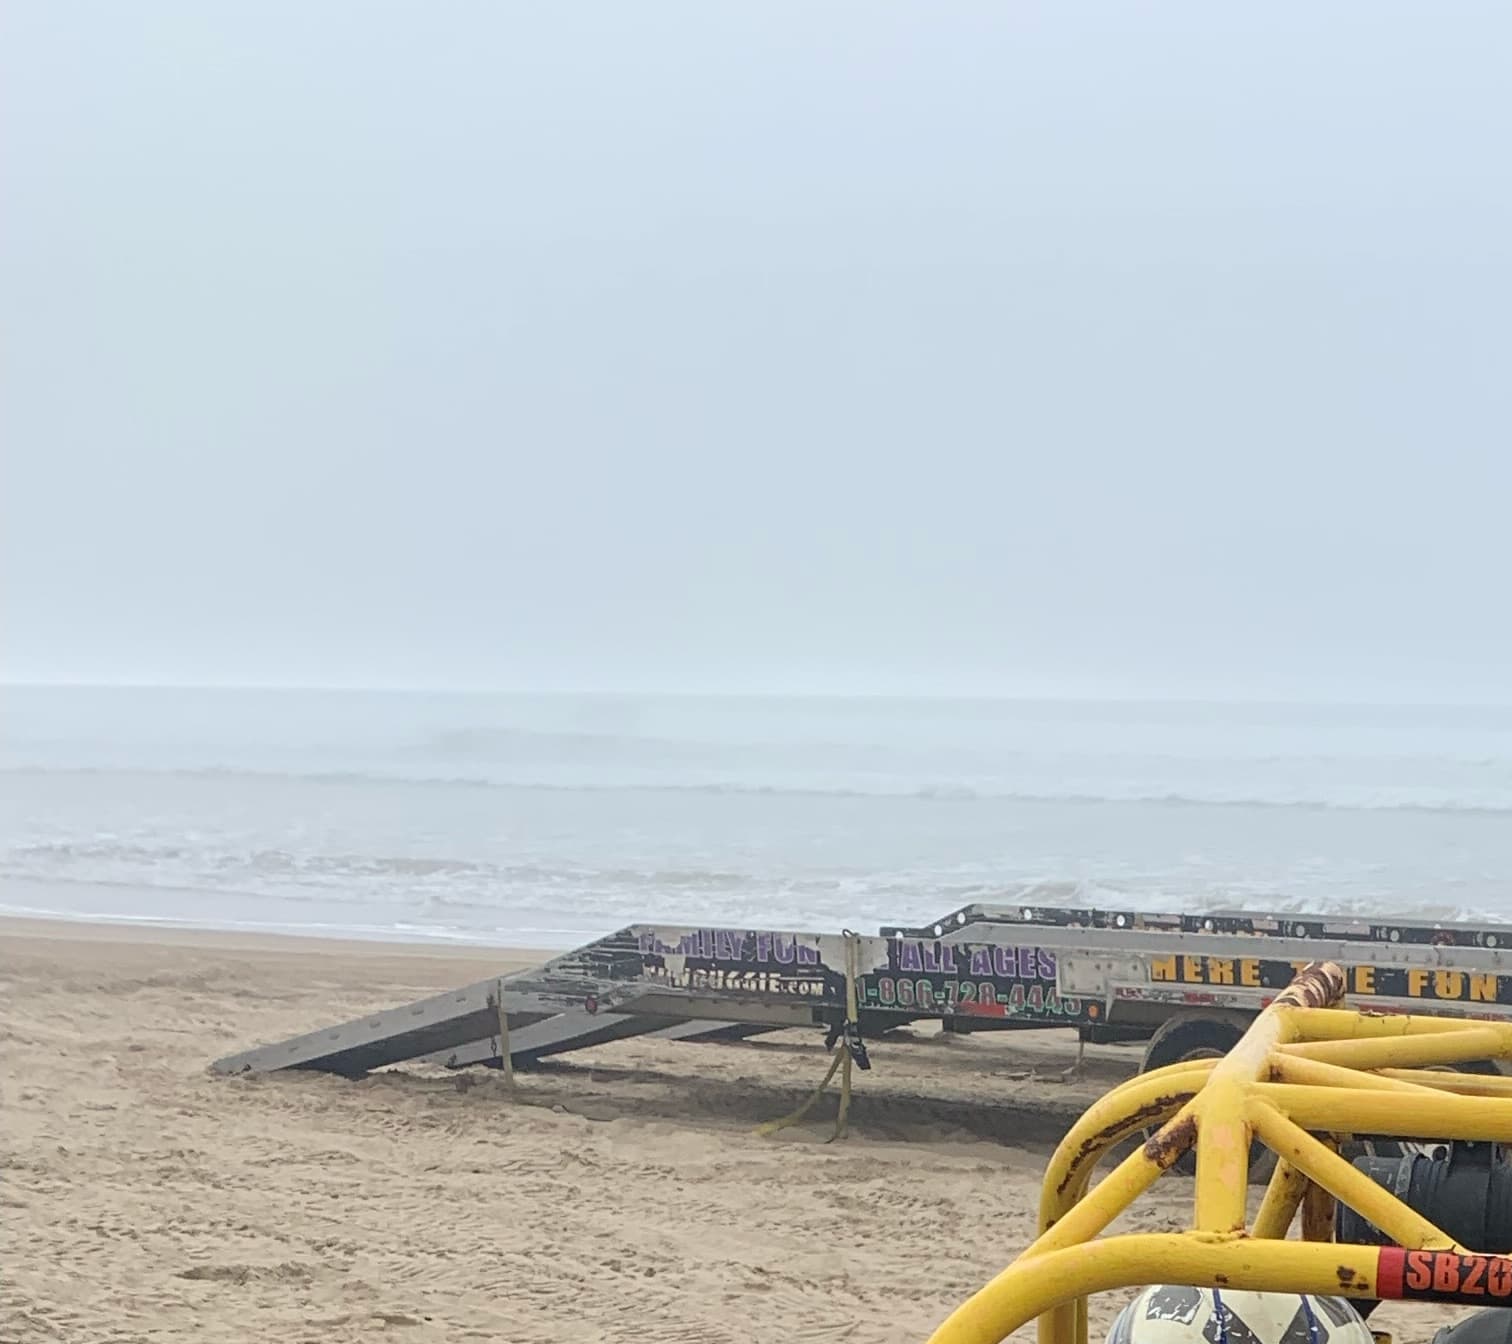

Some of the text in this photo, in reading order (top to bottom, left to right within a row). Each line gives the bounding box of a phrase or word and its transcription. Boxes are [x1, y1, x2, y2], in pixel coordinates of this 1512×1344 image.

[901, 940, 958, 975] ALL
[970, 943, 1058, 980] AGES
[1407, 968, 1498, 1001] FUN
